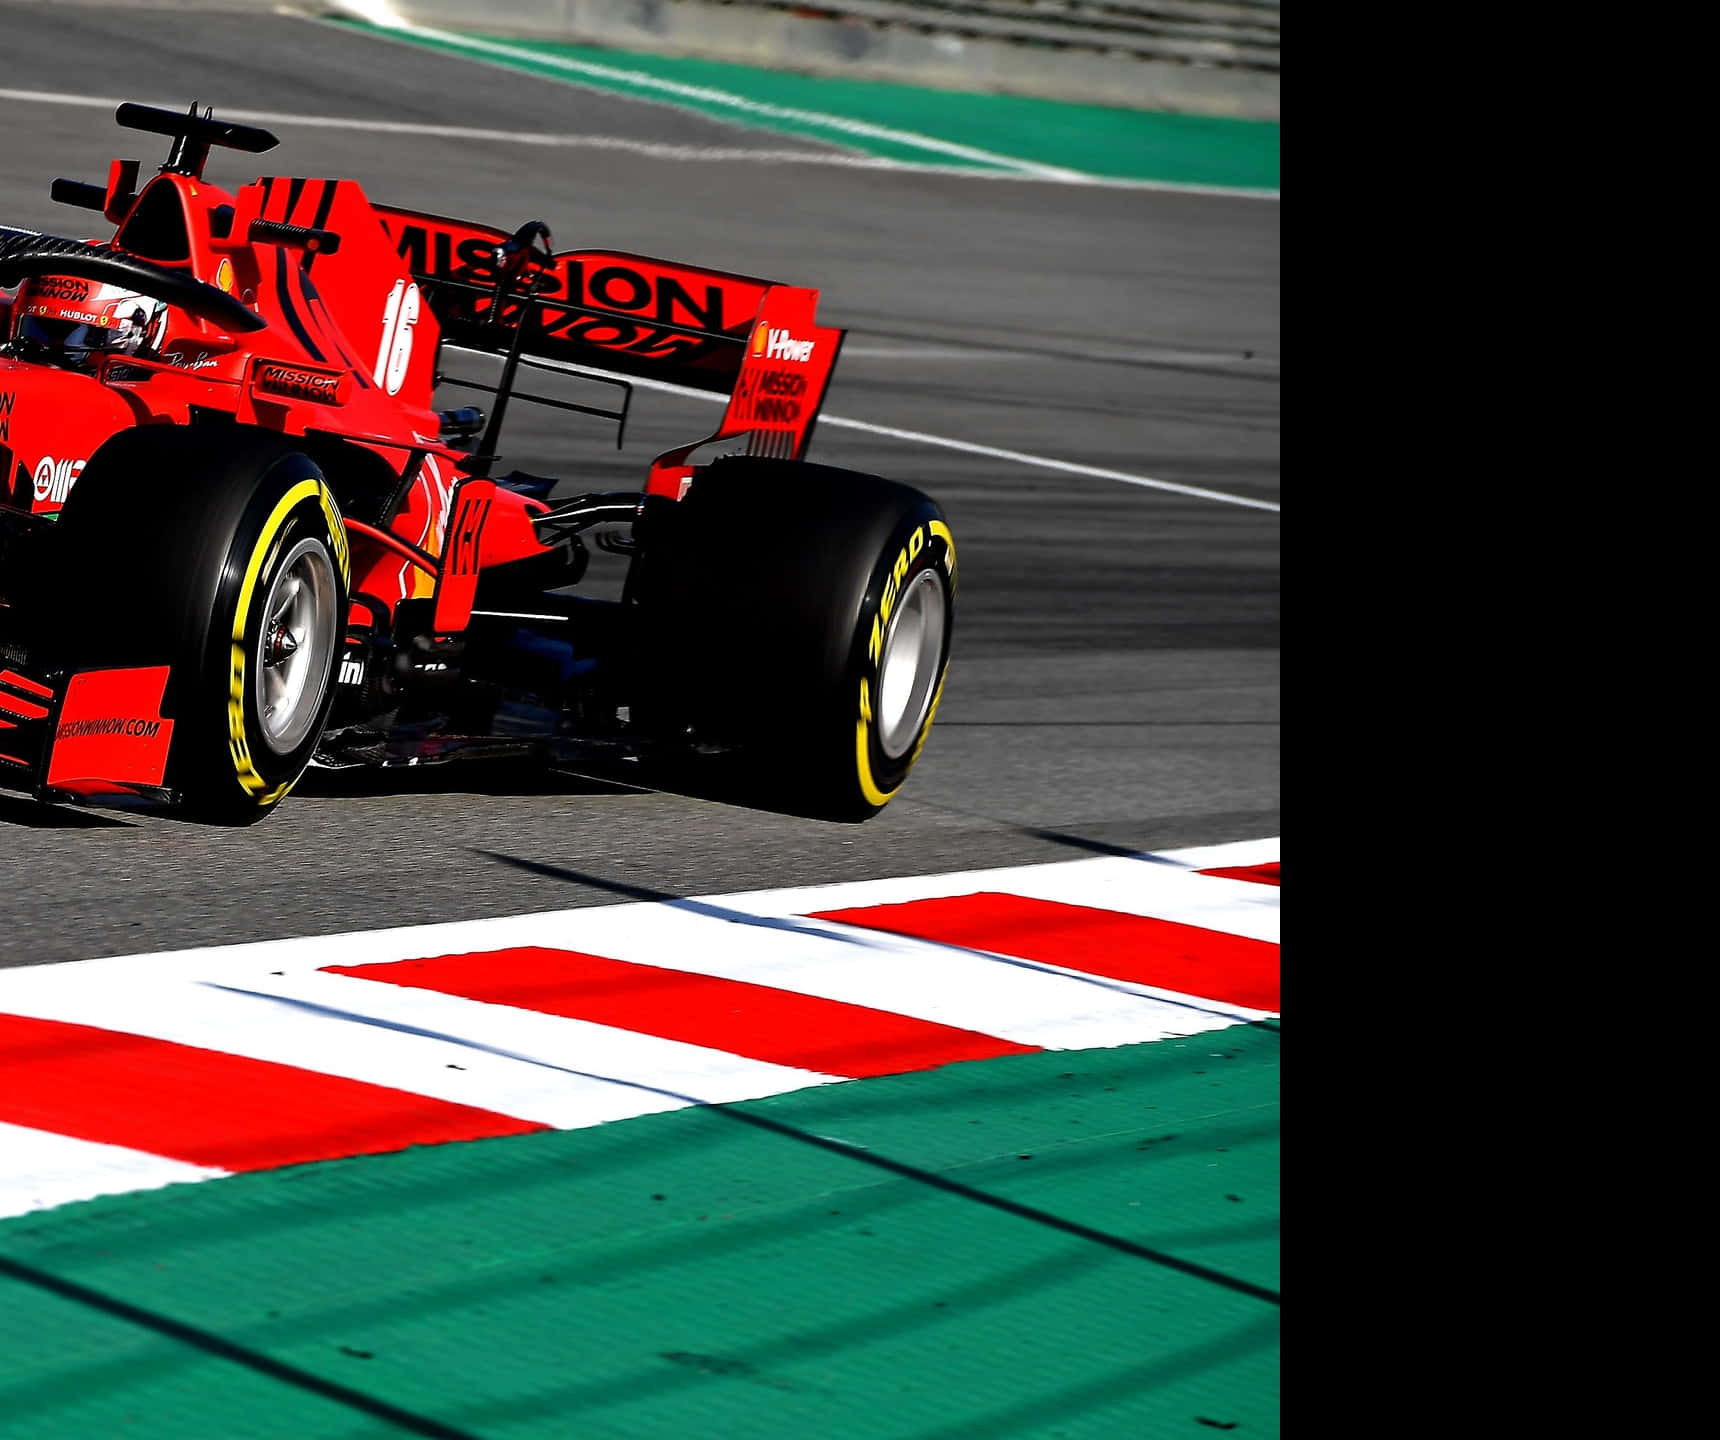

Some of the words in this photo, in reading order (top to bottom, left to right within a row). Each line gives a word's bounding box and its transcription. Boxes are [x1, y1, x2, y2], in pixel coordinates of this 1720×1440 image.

[60, 309, 98, 322] HUBLOT
[372, 278, 420, 396] 16
[164, 351, 218, 371] Ray-Ban
[263, 366, 340, 390] MISSION
[868, 525, 924, 669] ZERO
